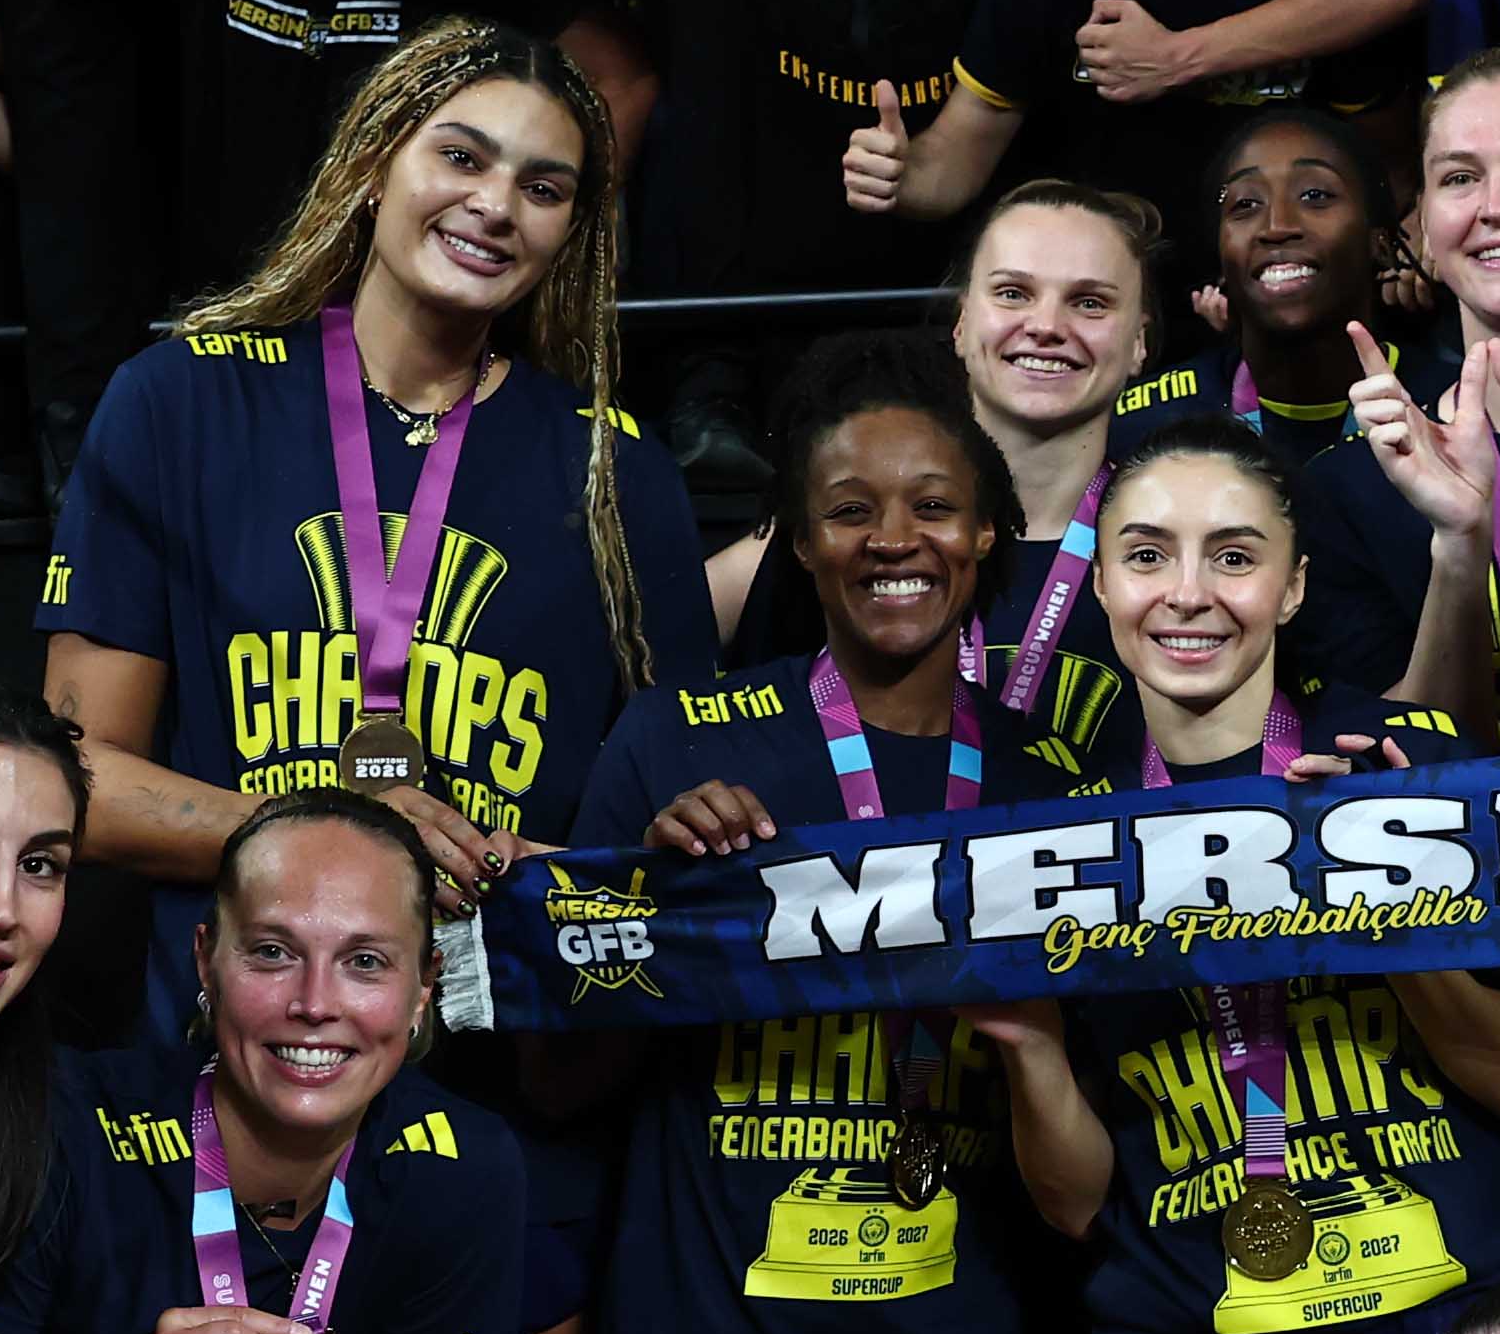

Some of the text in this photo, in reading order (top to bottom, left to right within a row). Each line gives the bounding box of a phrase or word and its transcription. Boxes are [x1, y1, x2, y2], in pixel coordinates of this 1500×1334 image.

[330, 12, 401, 34] GFB33
[354, 764, 409, 779] 2026
[557, 919, 655, 966] GFB
[1043, 891, 1490, 976] Genç Fenerbahçeliler
[708, 1113, 898, 1164] FENERBAHÇ
[1148, 1127, 1360, 1228] FENERHÇE
[808, 1225, 929, 1246] 2026 2027
[1360, 1234, 1401, 1259] 2027
[831, 1276, 904, 1295] SUPERCUP
[1323, 1265, 1353, 1284] tarfin
[1302, 1291, 1383, 1323] SUPERCUP
